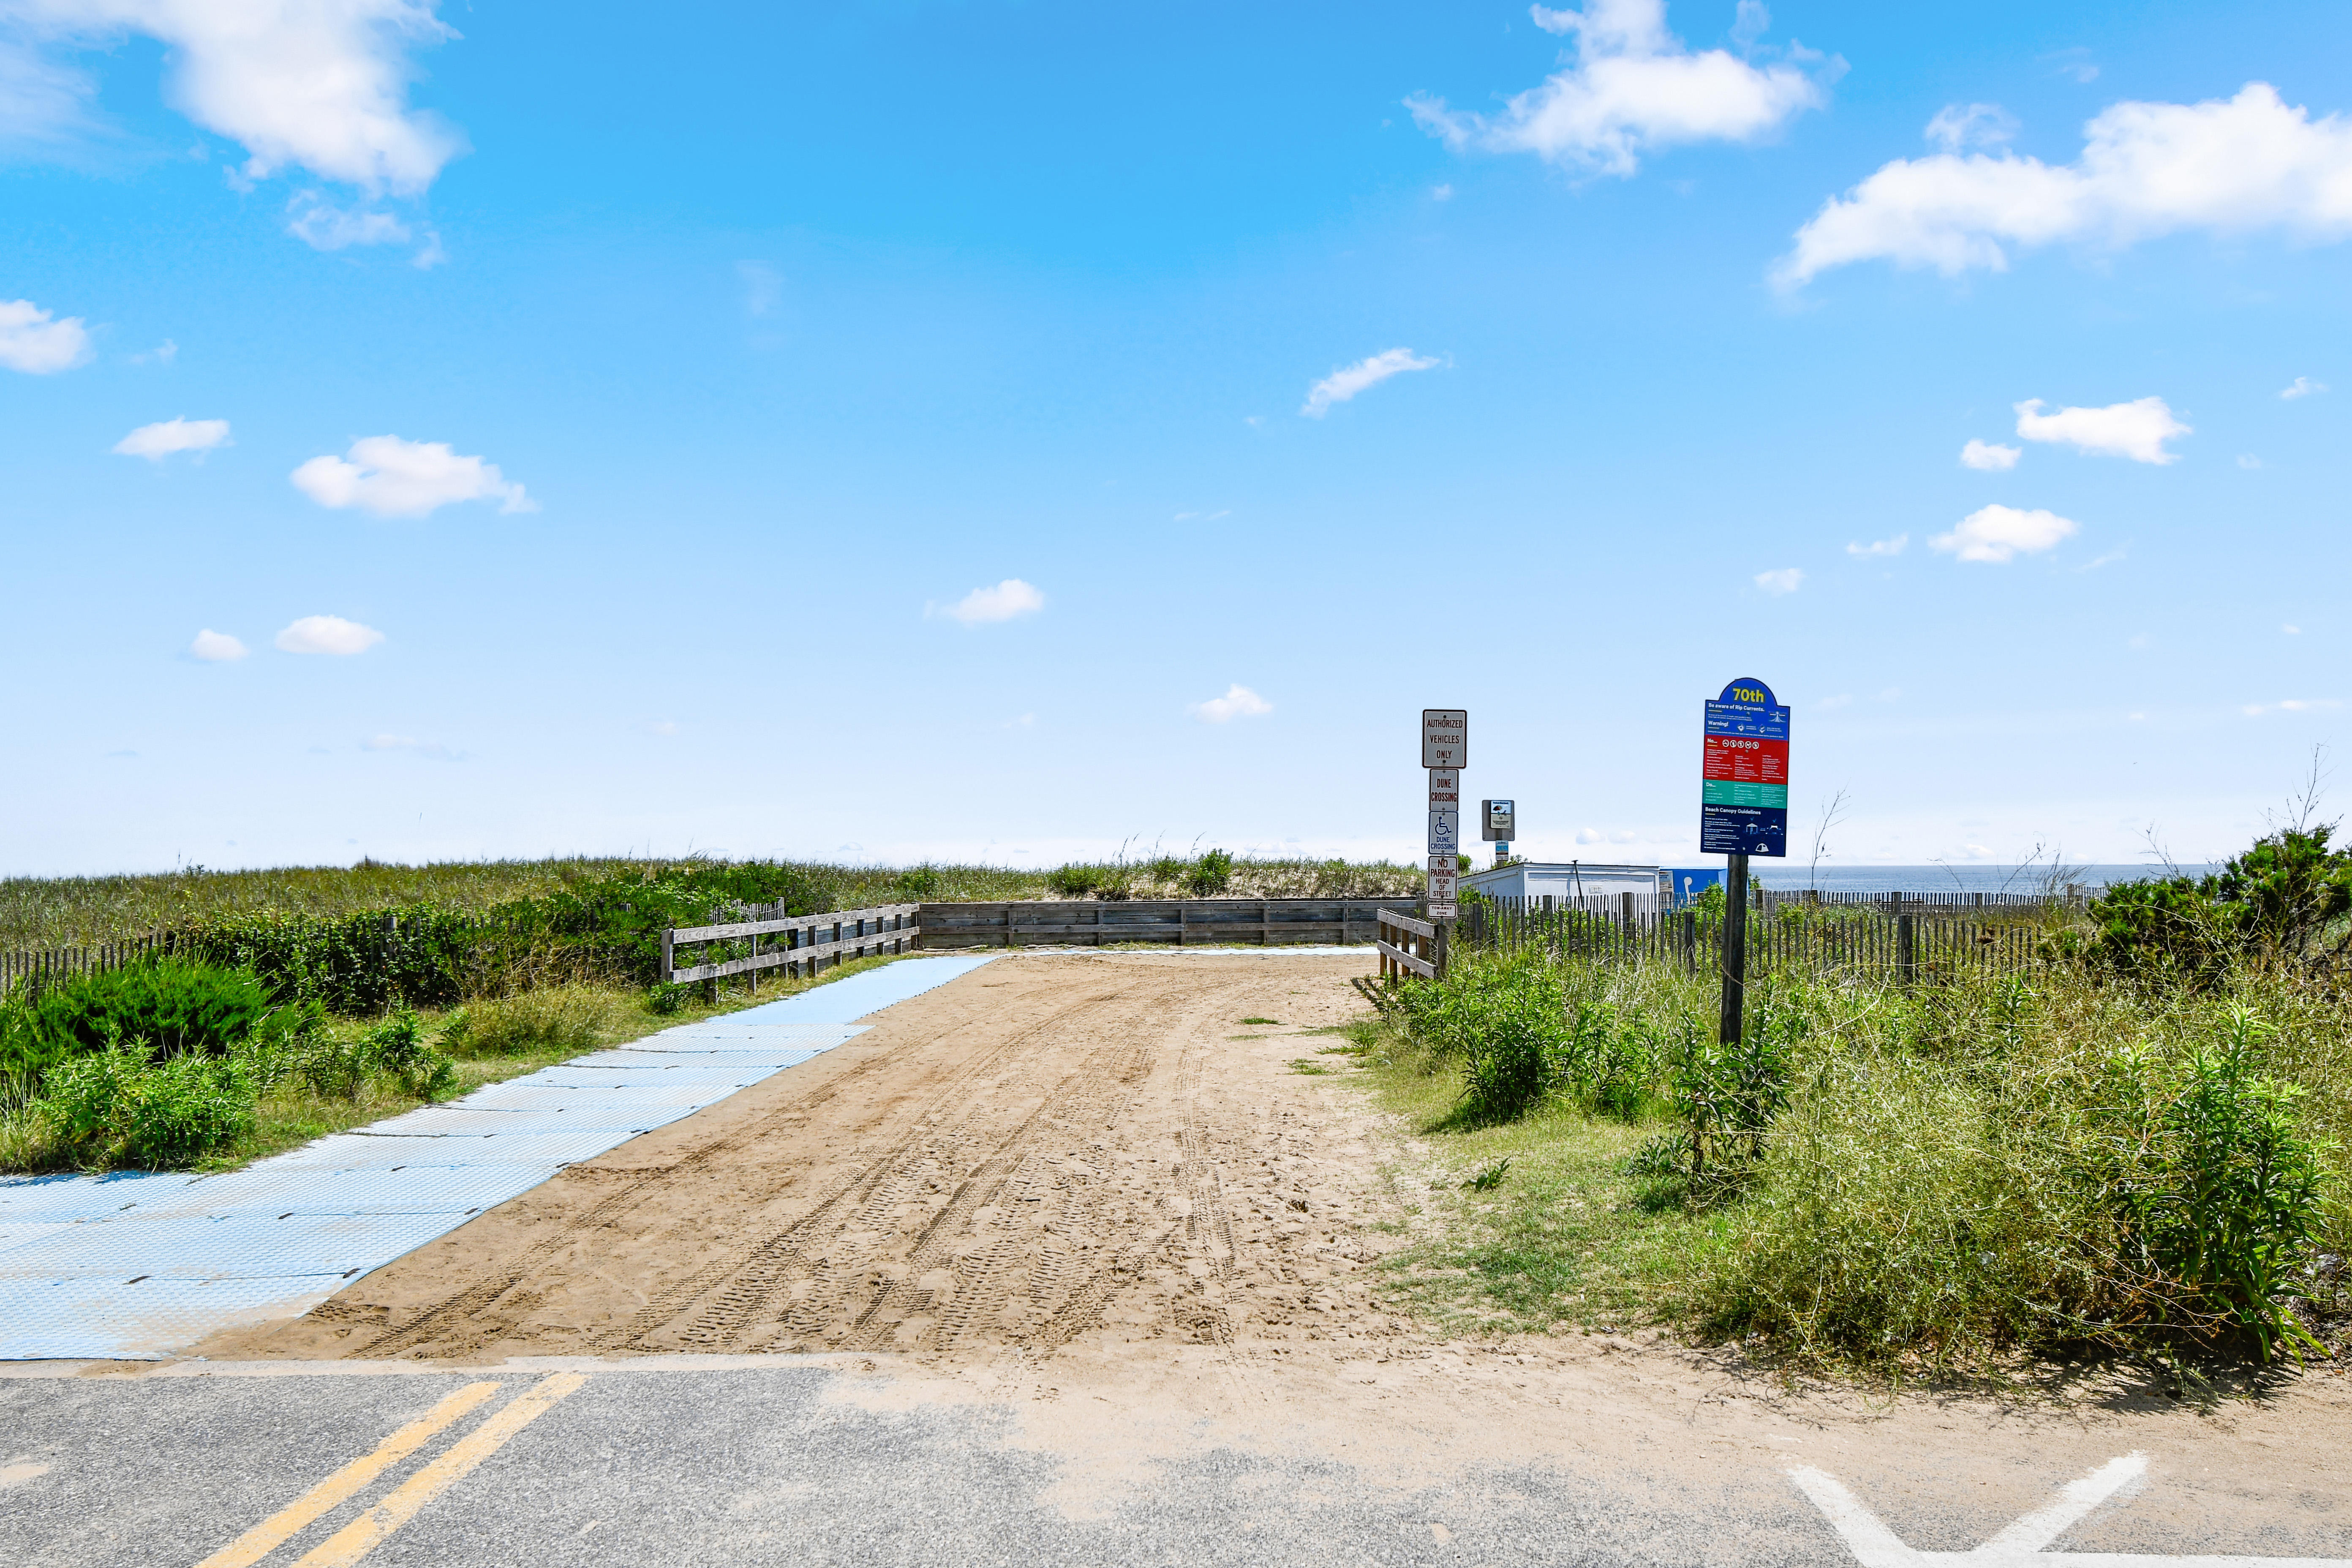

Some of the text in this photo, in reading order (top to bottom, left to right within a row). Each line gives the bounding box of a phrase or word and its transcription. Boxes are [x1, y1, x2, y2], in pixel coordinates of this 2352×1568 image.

[1733, 688, 1764, 702] 70th
[1427, 719, 1463, 728] AUTHORIZED
[1430, 735, 1459, 743] VEHICLES
[1436, 750, 1452, 759] ONLY
[1437, 779, 1451, 788] DUNE
[1431, 792, 1457, 802] CROSSING
[1437, 859, 1448, 868] NO
[1430, 868, 1455, 877] PARKING
